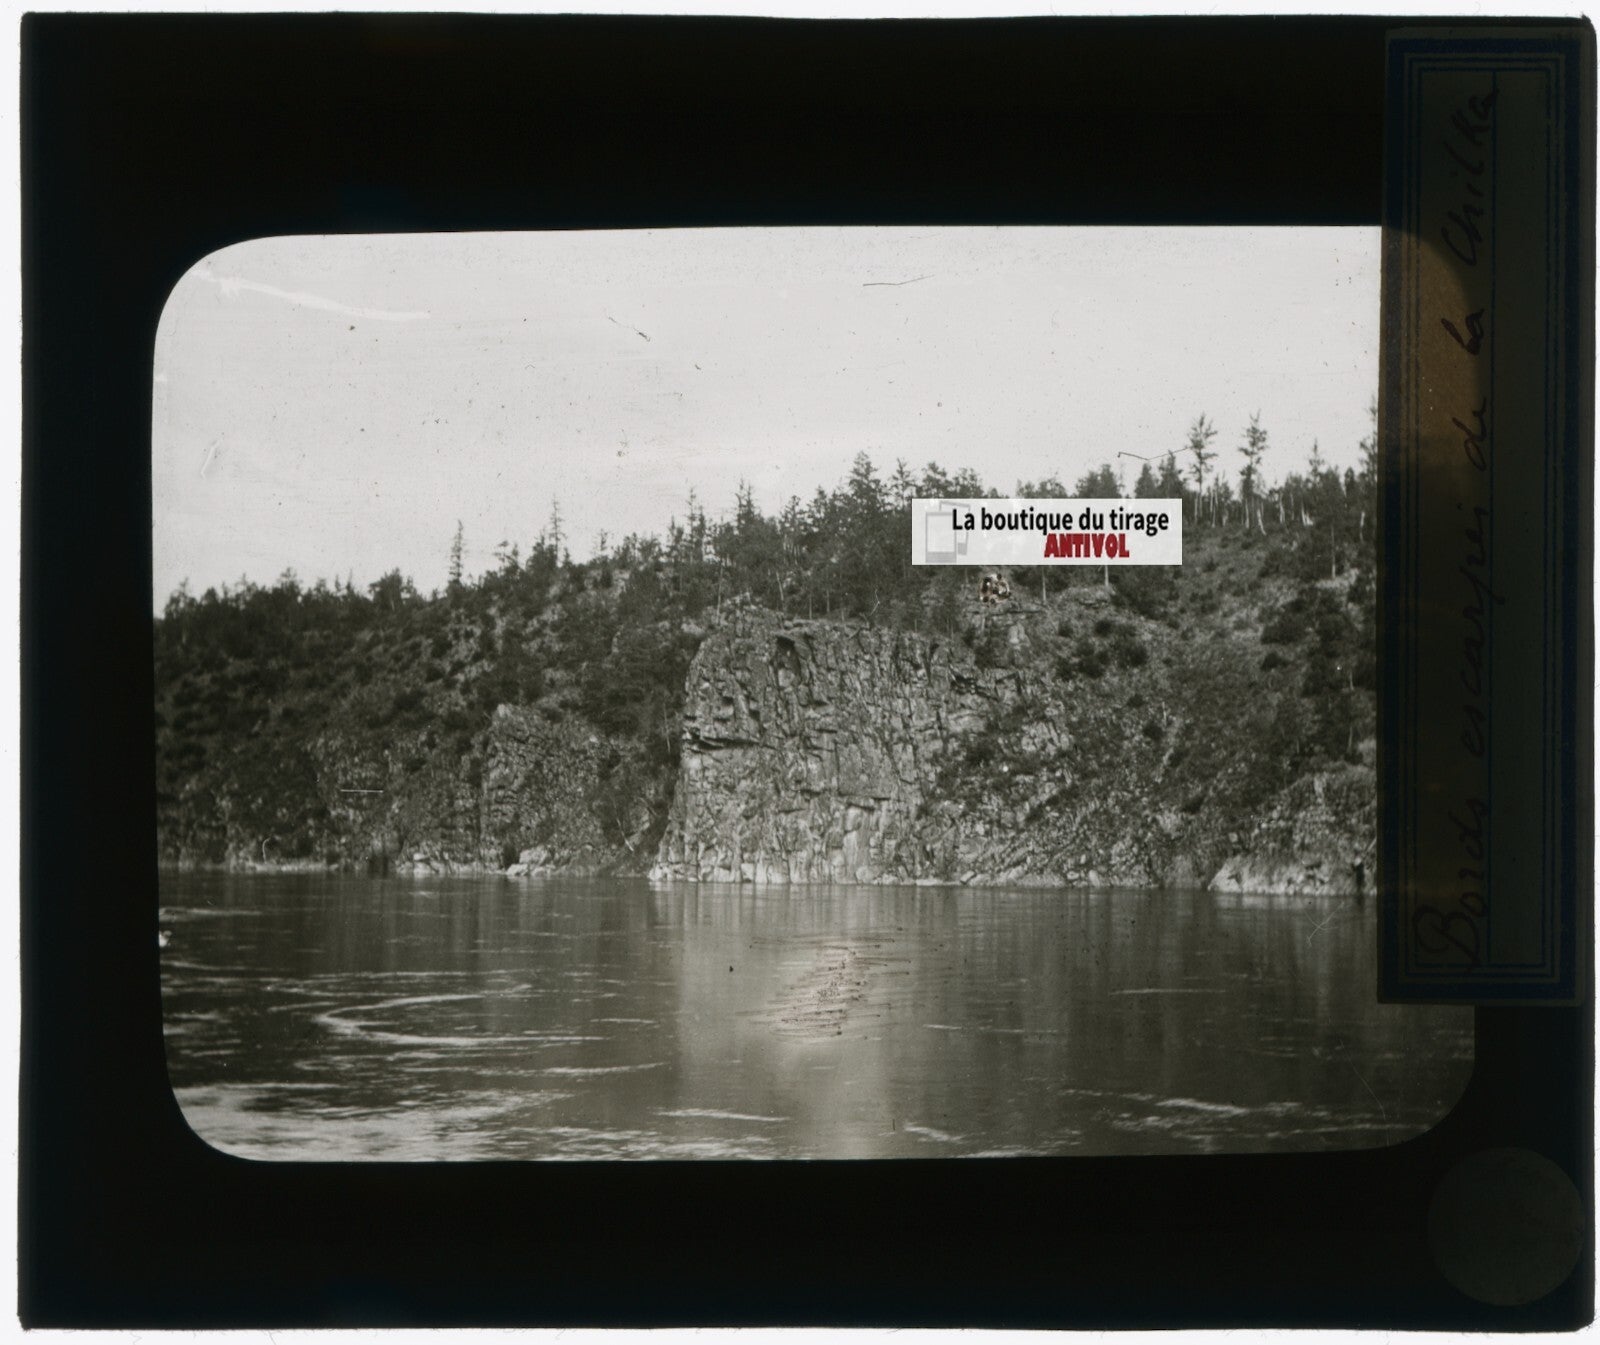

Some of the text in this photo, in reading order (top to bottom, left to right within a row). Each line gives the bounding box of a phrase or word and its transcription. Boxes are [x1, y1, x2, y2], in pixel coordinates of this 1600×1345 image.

[1440, 308, 1486, 356] la
[1452, 396, 1488, 472] de
[1411, 796, 1488, 973] Bords
